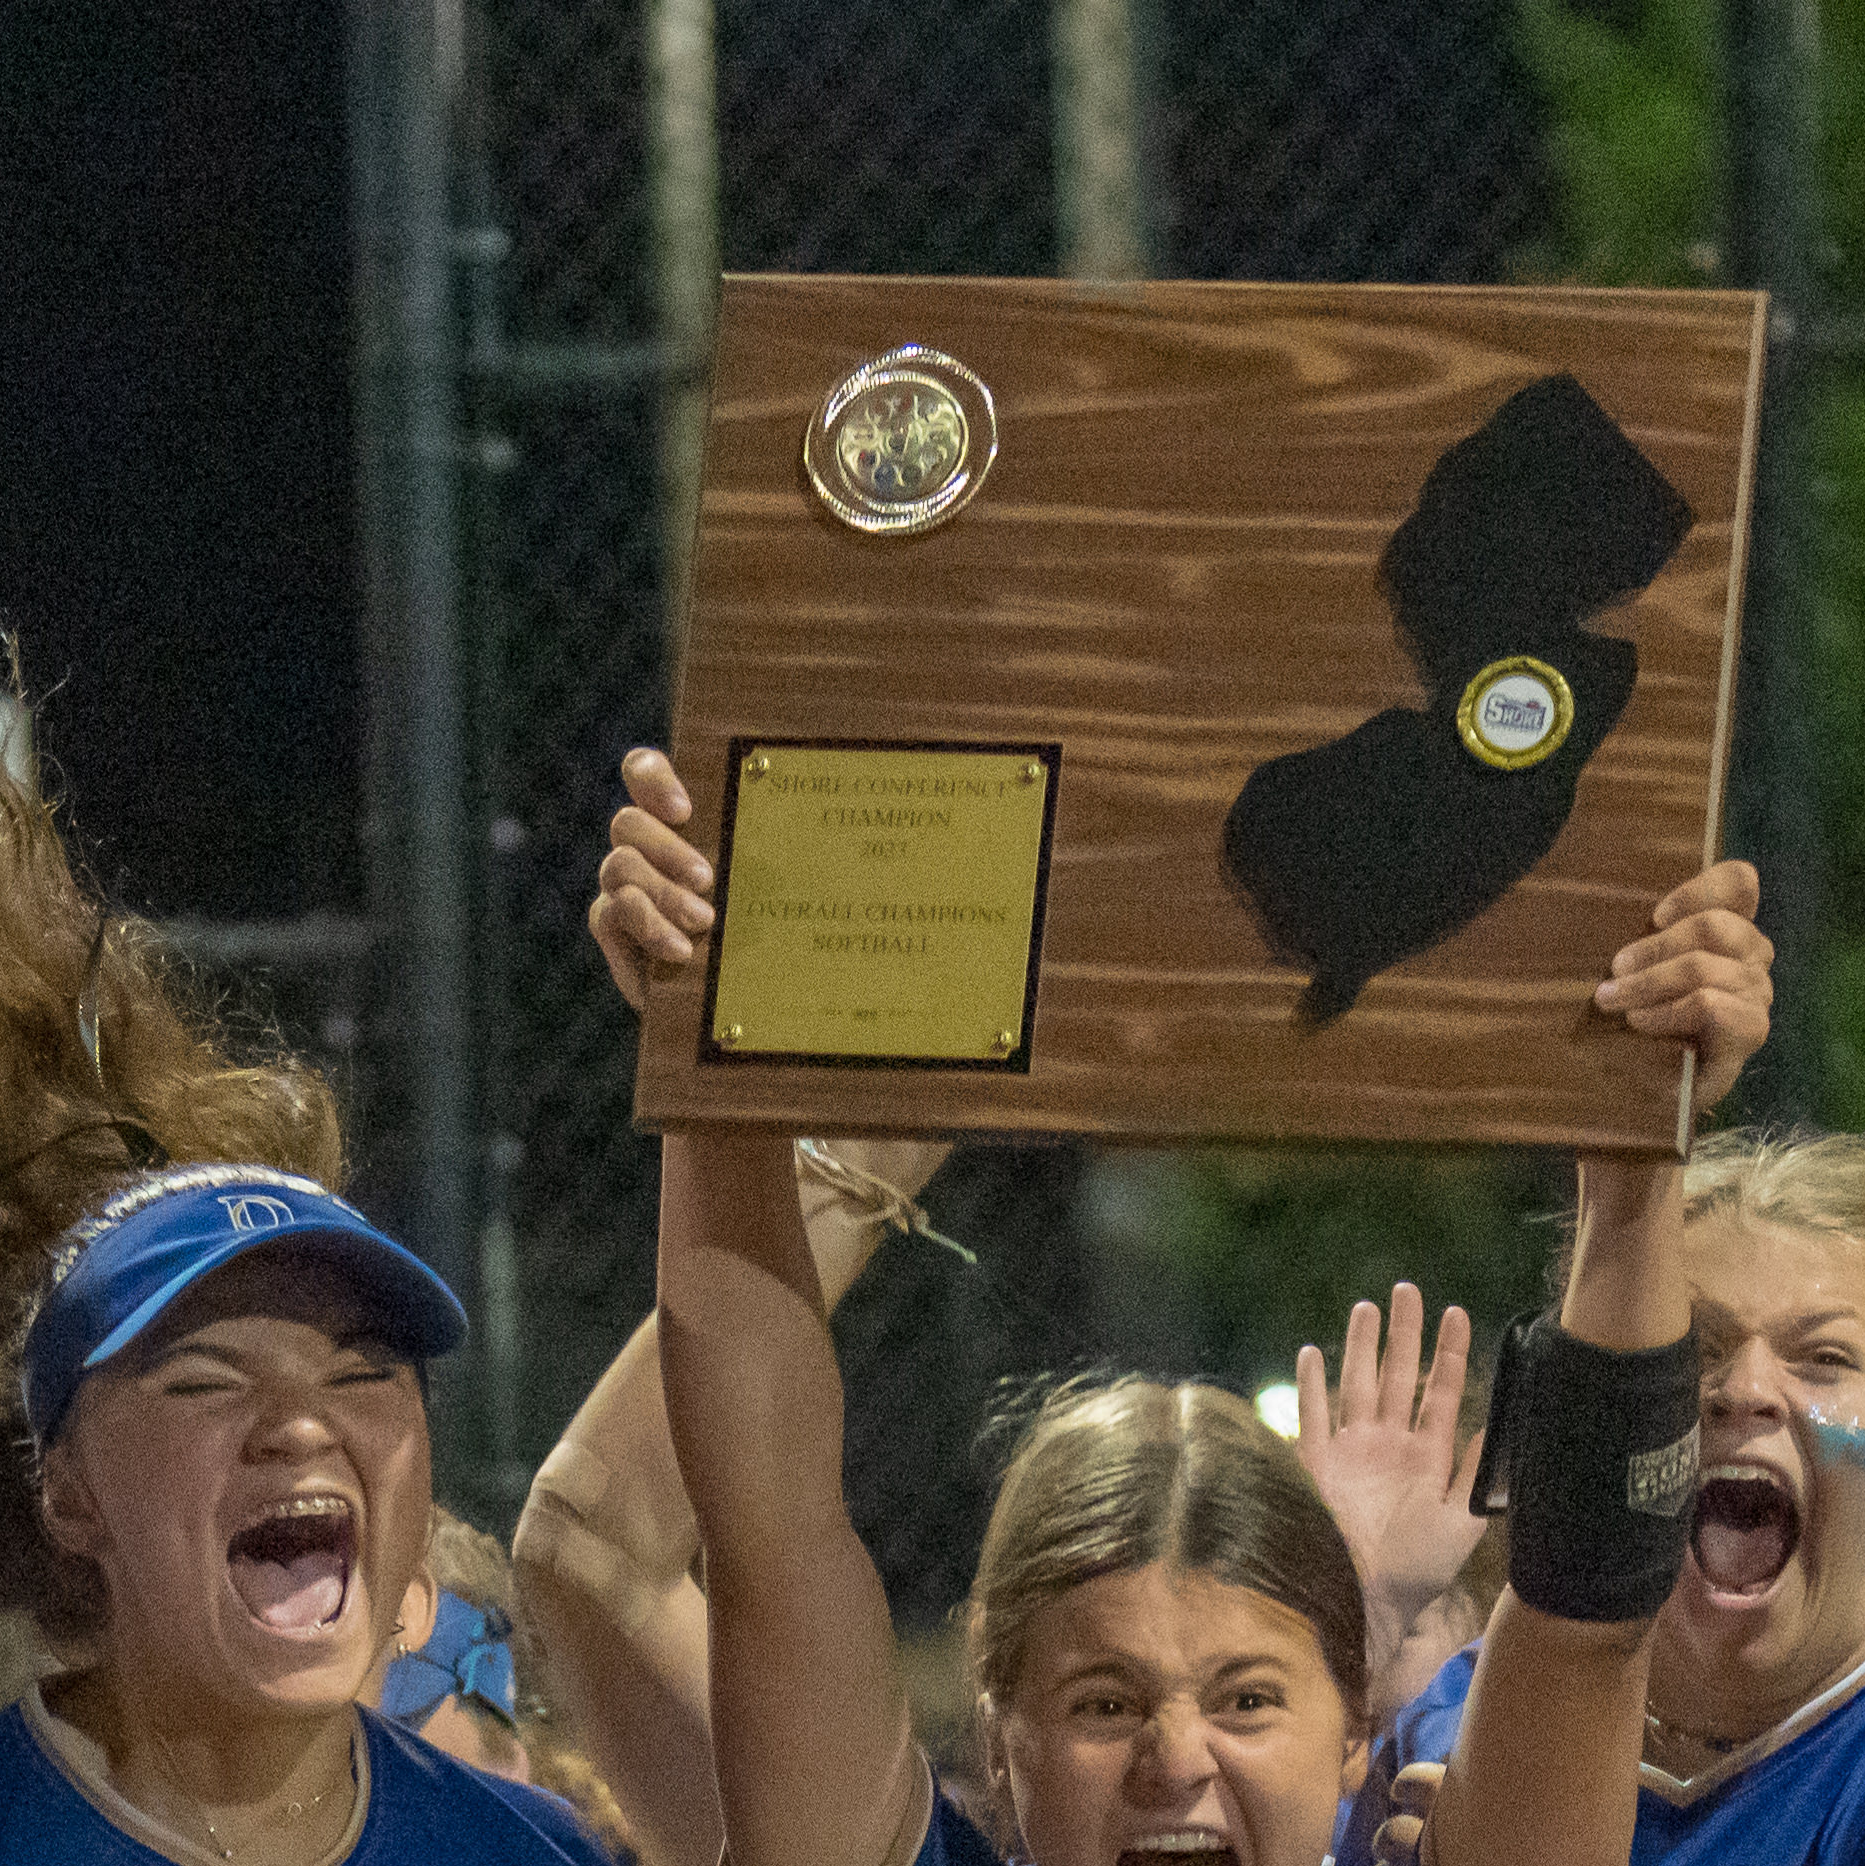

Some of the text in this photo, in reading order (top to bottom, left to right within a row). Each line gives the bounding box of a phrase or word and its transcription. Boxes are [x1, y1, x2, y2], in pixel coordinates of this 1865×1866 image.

[769, 775, 1007, 797] SHORE CONFERENCE
[820, 808, 953, 828] CHAMPION
[746, 899, 1007, 923] OVERALL CHAMPIONS
[811, 934, 930, 955] SOFTBALL
[217, 1194, 297, 1232] D
